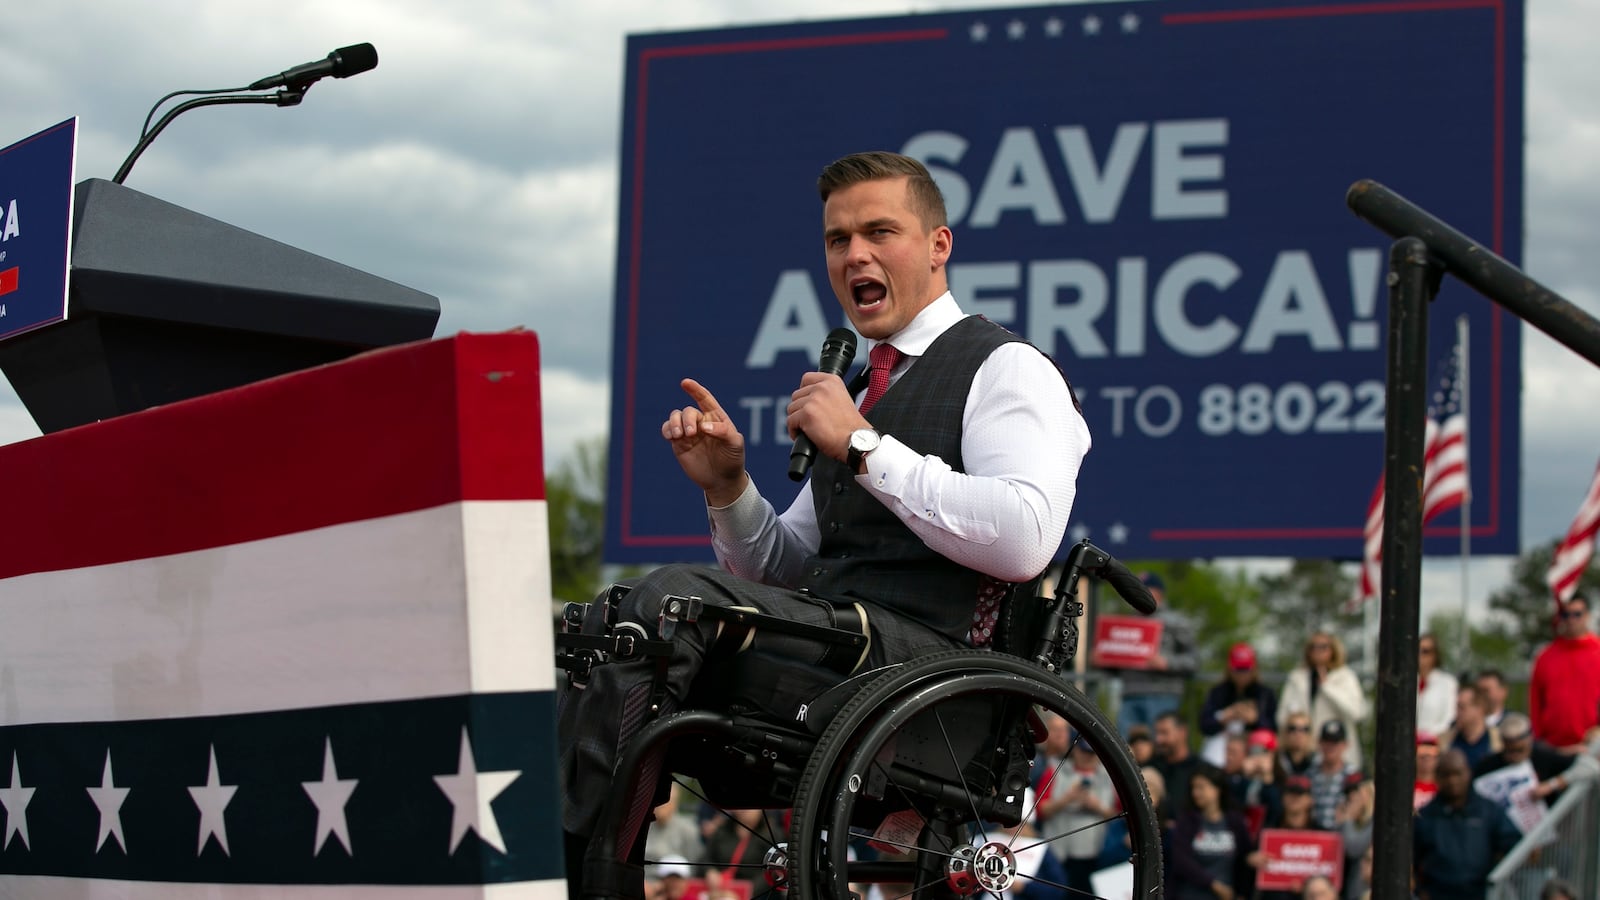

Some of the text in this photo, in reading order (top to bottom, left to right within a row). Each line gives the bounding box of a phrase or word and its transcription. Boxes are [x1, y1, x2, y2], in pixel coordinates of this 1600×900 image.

[902, 118, 1229, 229] SAVE
[745, 248, 1382, 368] AERICA!
[739, 378, 1386, 446] TE TO 88022
